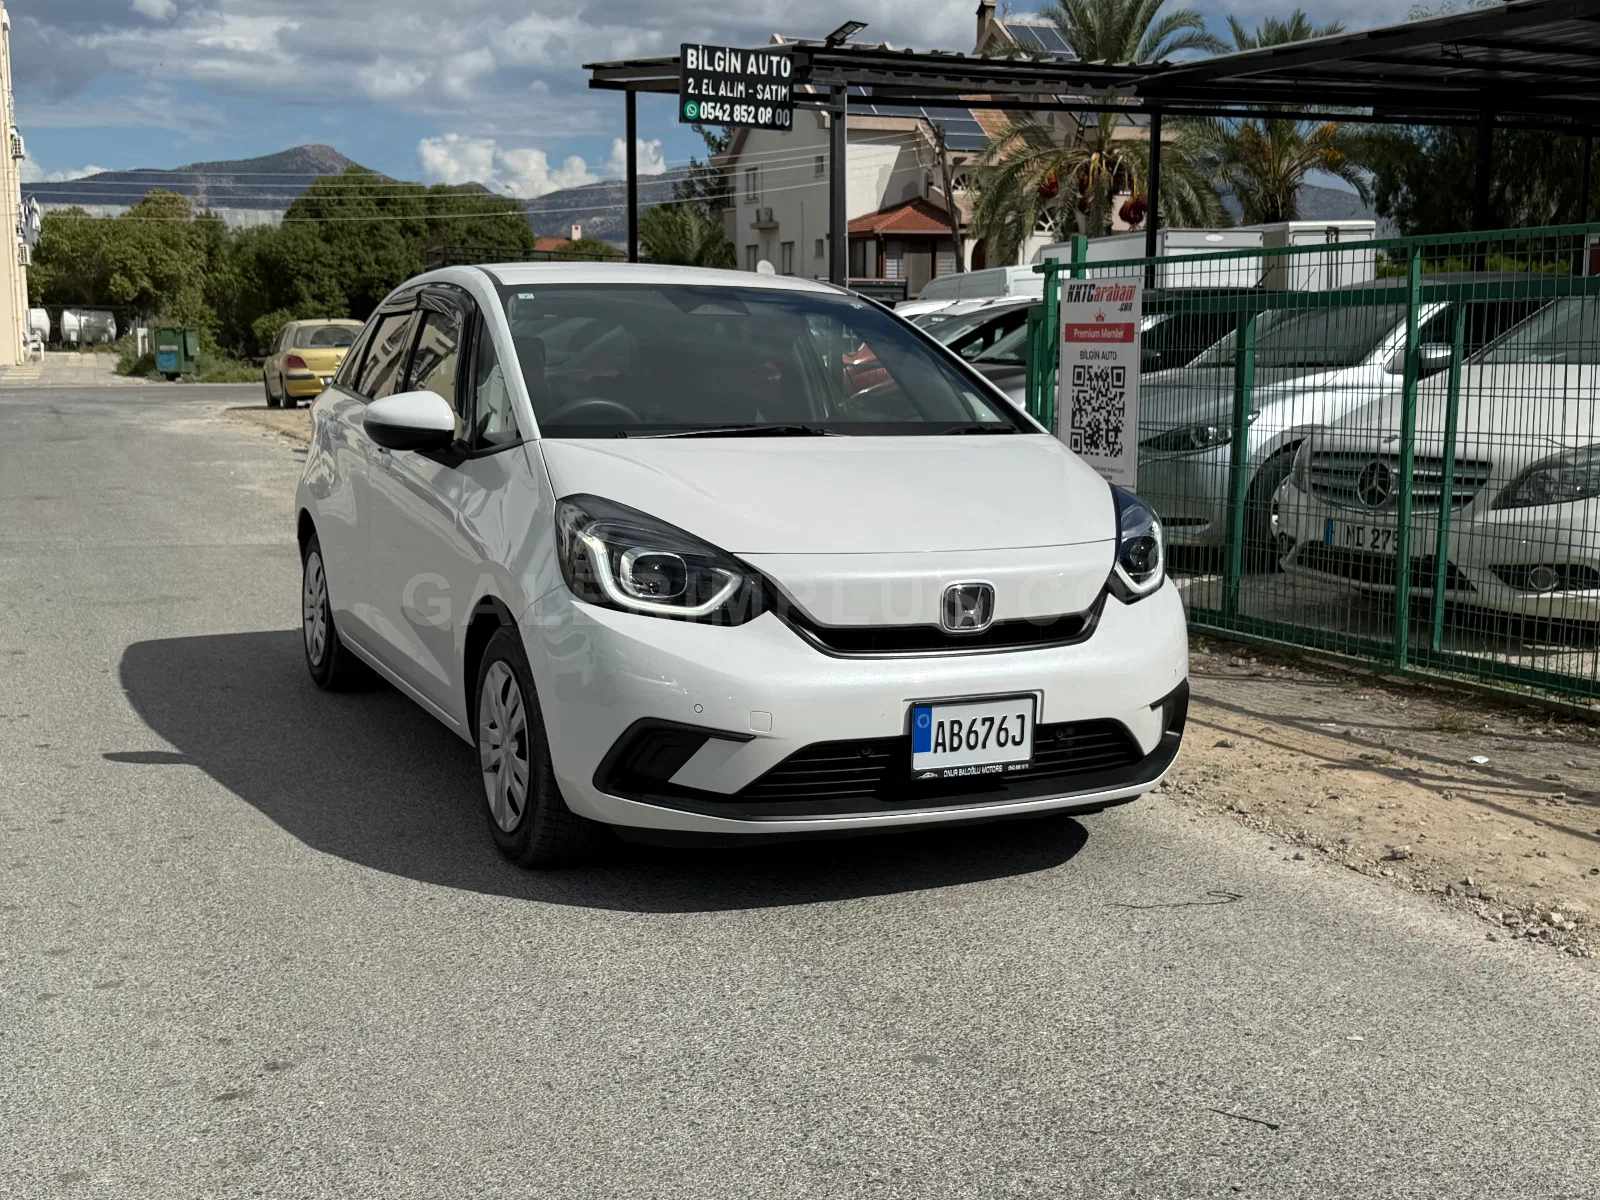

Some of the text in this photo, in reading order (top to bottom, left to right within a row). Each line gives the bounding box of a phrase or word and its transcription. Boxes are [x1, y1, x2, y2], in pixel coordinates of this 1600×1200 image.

[687, 45, 791, 78] BİLGİN AUTO
[687, 77, 699, 95] 2.
[702, 78, 716, 96] EL
[718, 80, 746, 98] ALIM
[756, 83, 789, 102] SATIM
[699, 101, 790, 126] 0542 852 08 00
[1073, 328, 1124, 339] Premium Member
[1080, 348, 1117, 360] BİLGİN AUTO
[933, 713, 1026, 754] AB676J
